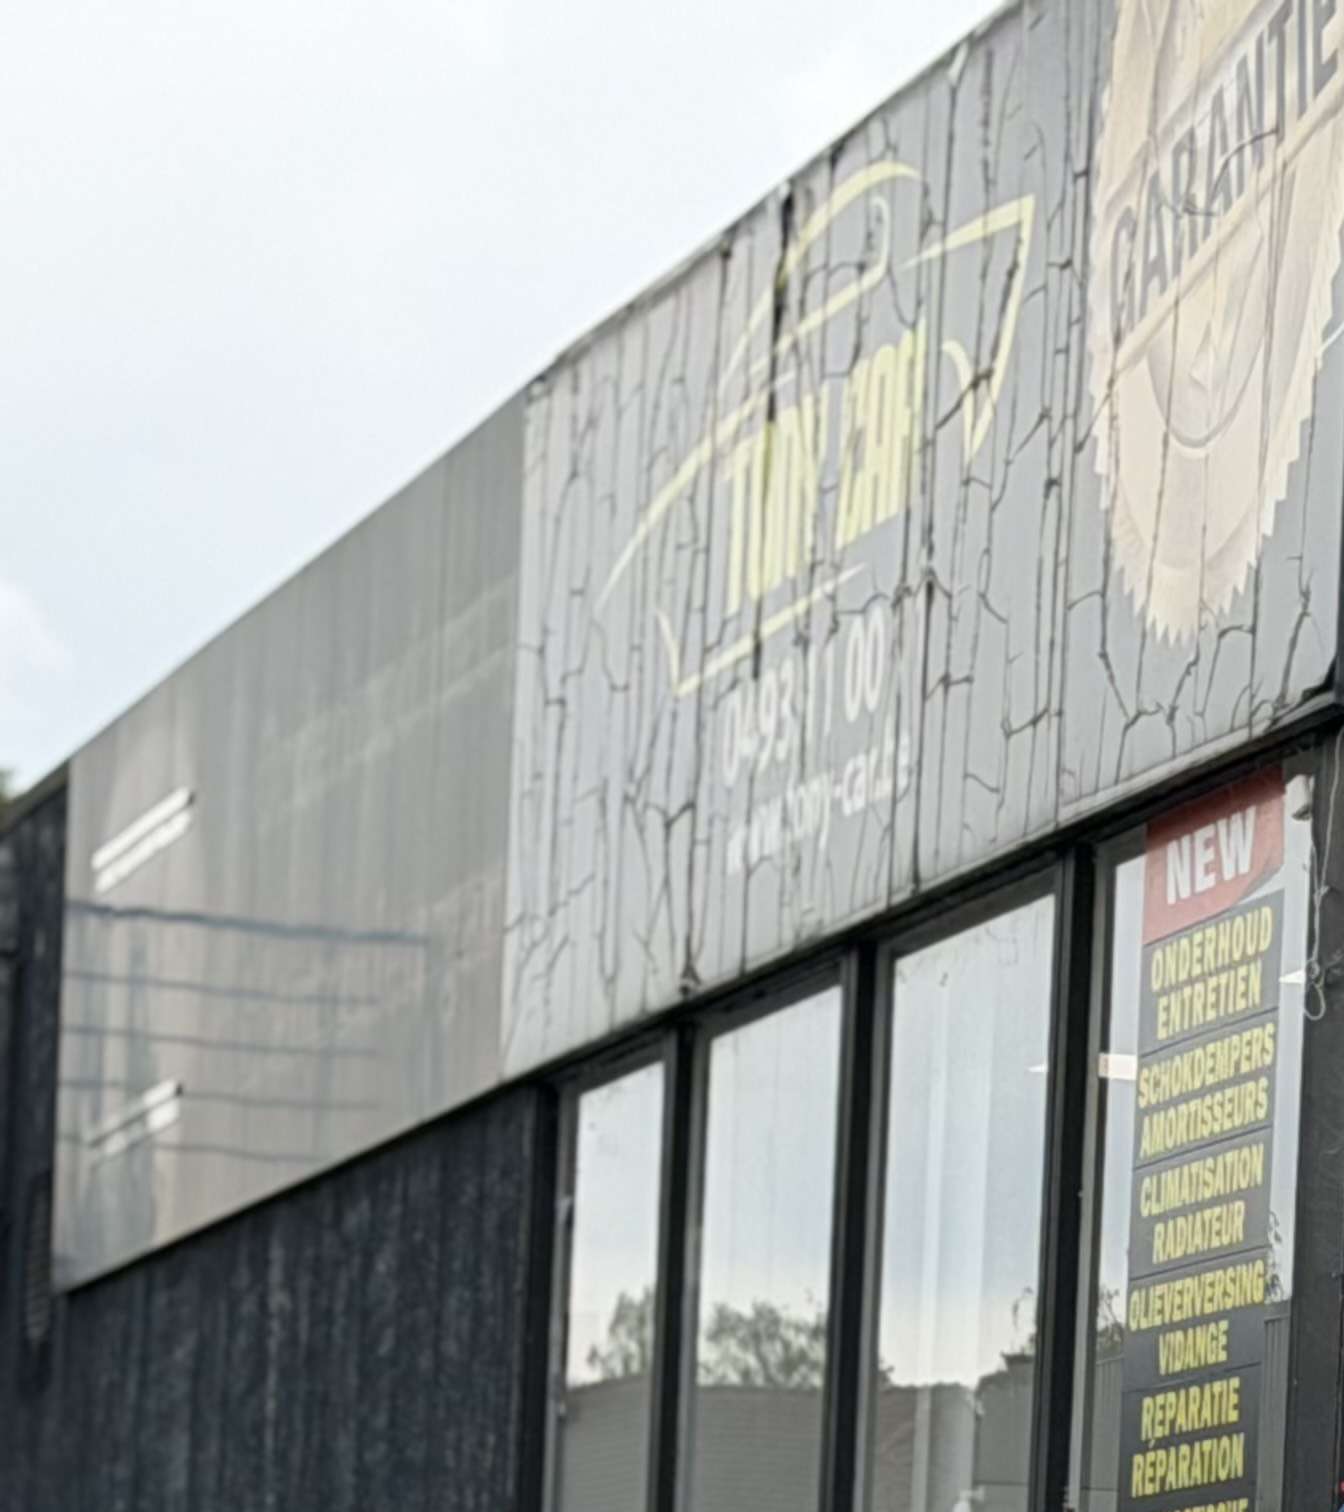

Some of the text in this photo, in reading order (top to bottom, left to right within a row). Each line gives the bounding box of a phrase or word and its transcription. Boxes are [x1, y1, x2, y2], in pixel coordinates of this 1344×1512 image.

[1166, 805, 1257, 905] NEW
[1151, 906, 1273, 992] ONDERHOUD
[1157, 960, 1261, 1041] ENTRETIEN
[1137, 1023, 1275, 1108] SCHOKDEMPERS
[1140, 1077, 1268, 1159] AMORTISSEURS
[1140, 1143, 1264, 1219] CLIMATISATION
[1152, 1201, 1246, 1264] RADIATEUR
[1127, 1260, 1266, 1332] OLIEVERVERSING
[1157, 1319, 1228, 1376] VIDANGE
[1140, 1377, 1241, 1442] REPARATIE
[1130, 1432, 1244, 1498] RÉPARATION
